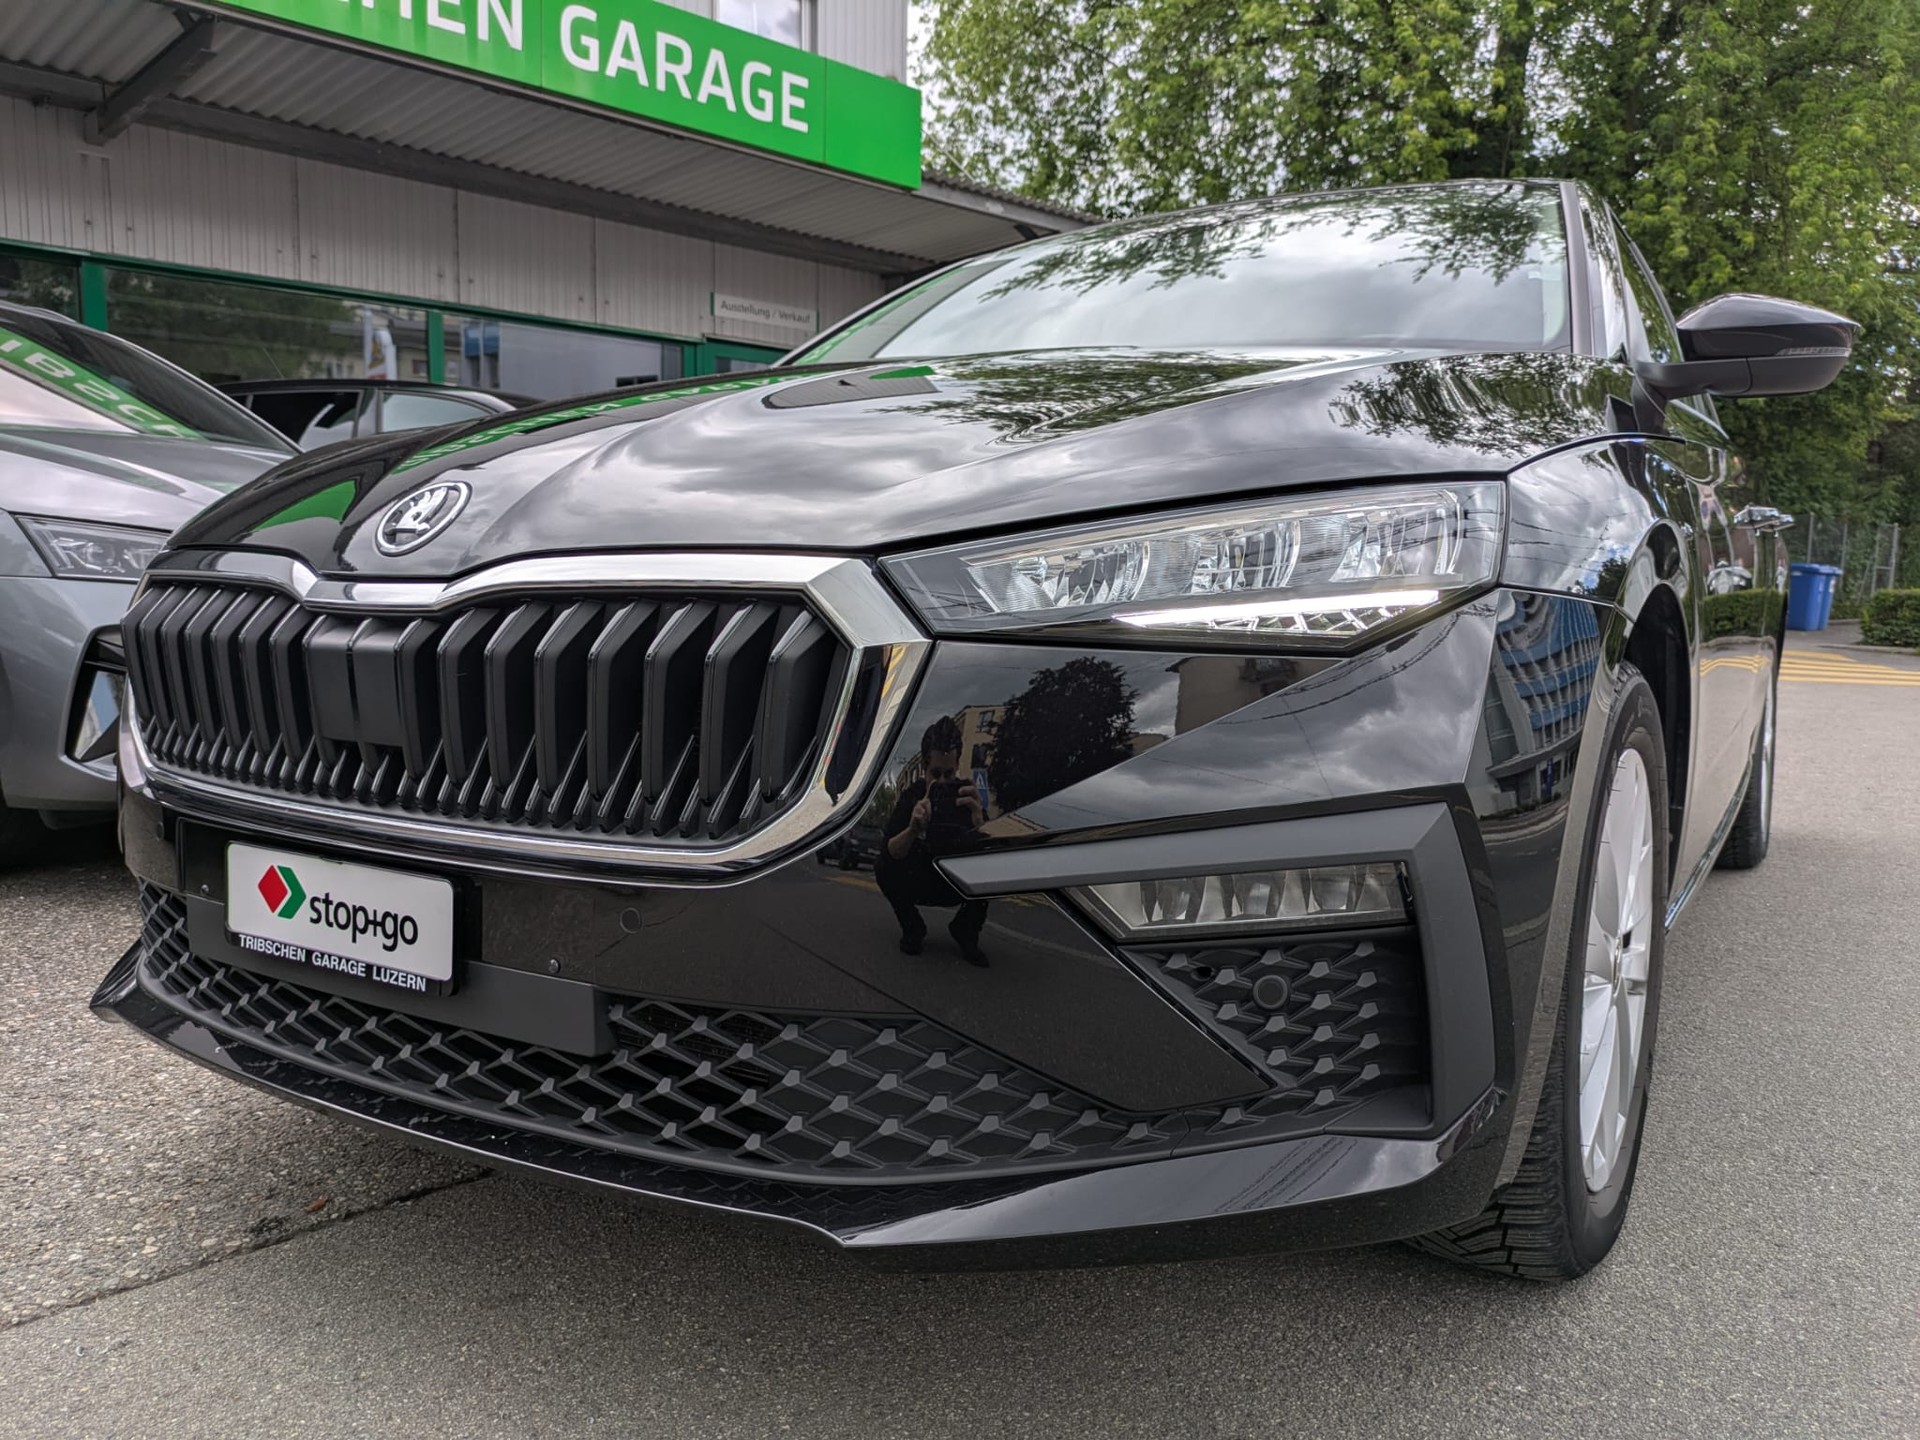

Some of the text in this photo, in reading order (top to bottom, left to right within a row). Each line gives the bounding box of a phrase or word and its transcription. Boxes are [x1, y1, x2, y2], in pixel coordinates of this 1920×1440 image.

[559, 4, 809, 134] GARAGE
[778, 311, 811, 324] Verkauf
[309, 892, 419, 953] stop+go
[238, 934, 427, 992] TRIBSCHEN GARAGE LUZERN
